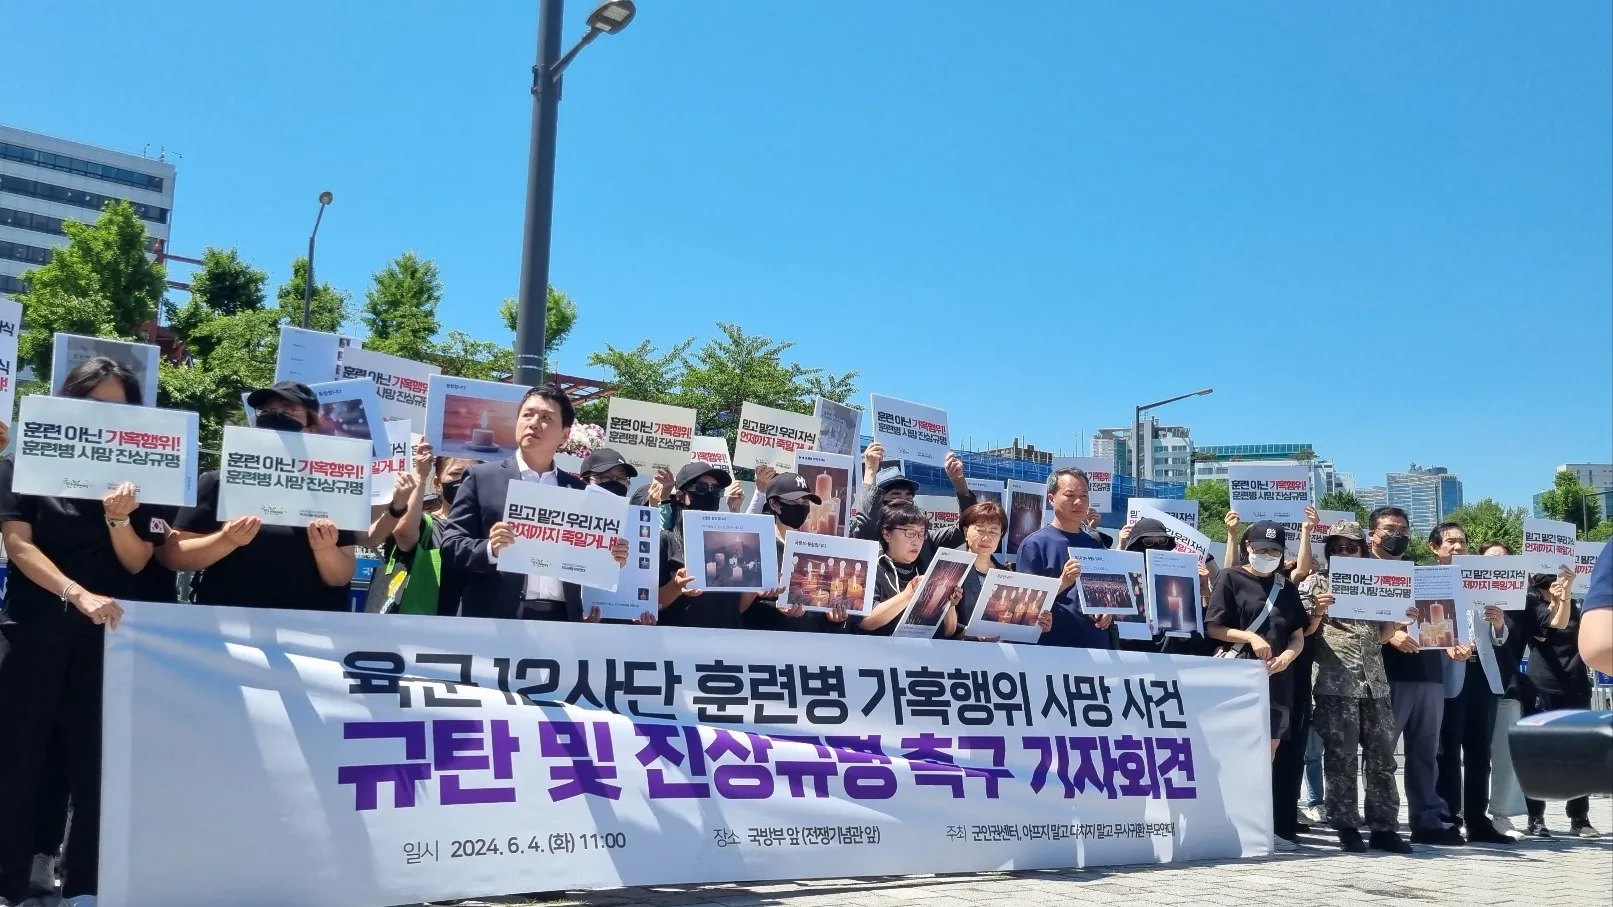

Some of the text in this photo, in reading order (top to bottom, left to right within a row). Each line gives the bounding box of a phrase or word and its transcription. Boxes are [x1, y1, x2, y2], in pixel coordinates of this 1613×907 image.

[610, 417, 692, 439] 훈련 아닌 가혹행위!
[742, 419, 817, 444] 믿고 맡긴 우리 자식
[877, 411, 947, 435] 훈련 아닌 가혹행위!
[878, 422, 947, 446] 훈련병 사망 진상규명
[23, 421, 181, 452] 훈련 아닌 가혹행위!
[608, 431, 691, 452] 훈련병 사망 진상규명
[740, 431, 775, 448] 언제까지
[22, 440, 181, 469] 훈련병 사망 진상규명
[692, 451, 728, 463] 가혹행위!
[227, 452, 364, 480] 훈련 아닌 가혹행위!
[371, 458, 406, 475] 일거냐!
[226, 470, 364, 496] 훈련병 사망 진상규명
[1231, 480, 1307, 491] 훈련 아닌 가혹행위!
[1232, 491, 1308, 501] 훈련병 사망 진상규명
[508, 503, 621, 535] 믿고 맡긴 우리 자식
[506, 521, 559, 544] 언제까지
[1525, 532, 1541, 542] 믿고
[1541, 533, 1556, 543] 맡긴
[1525, 542, 1556, 554] 언제까지
[1331, 573, 1412, 587] 훈련 아닌 가혹행위!
[1461, 569, 1526, 579] 고 맡긴 우리 자식
[1463, 580, 1524, 590] 제까지 죽일거냐!
[1331, 584, 1411, 598] 훈련병 사망 진상규명
[343, 651, 1187, 729] 육군 12사단 훈련병 가혹행위 사망 사건
[338, 719, 1197, 811] 규탄 및 진상규명 촉구 기자회견
[713, 825, 881, 848] 장소 국방부 앞 (전쟁기념관 앞)
[946, 825, 966, 842] 주최
[972, 824, 1021, 842] 군인권센터,
[1022, 823, 1050, 841] 아프지
[1050, 823, 1070, 841] 말고
[1070, 823, 1095, 840] 다치지
[1096, 823, 1113, 840] 말고
[1114, 823, 1145, 839] 무사귀환
[403, 832, 626, 864] 일시 2024. 6. 4. (화) 11:00
